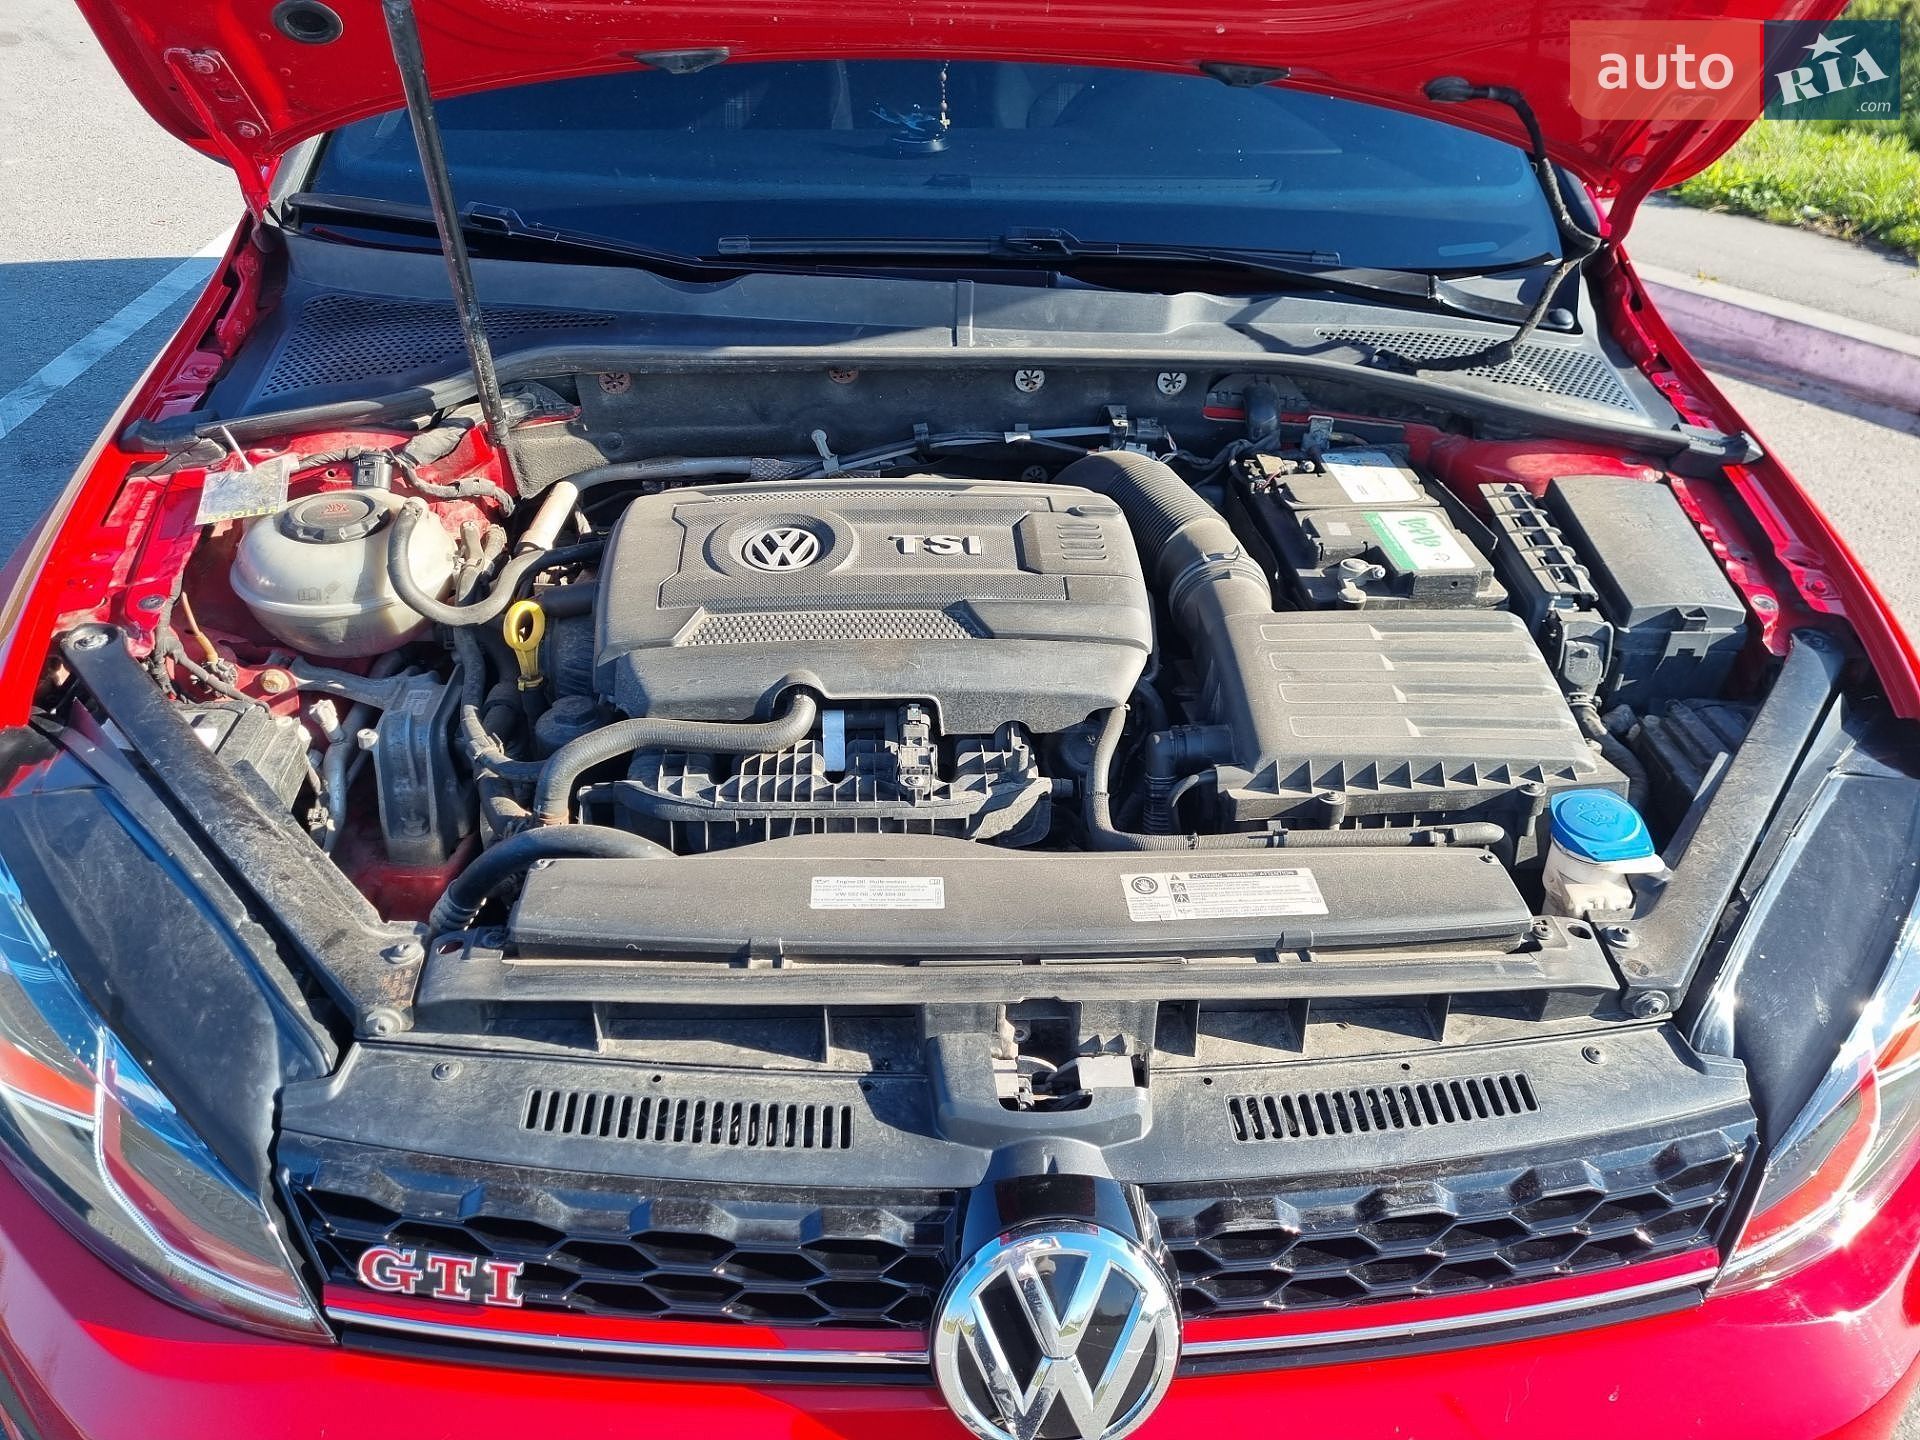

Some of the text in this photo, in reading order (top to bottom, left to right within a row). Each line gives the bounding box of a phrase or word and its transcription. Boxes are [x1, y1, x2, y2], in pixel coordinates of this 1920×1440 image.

[745, 527, 820, 572] VW
[888, 534, 983, 556] TSI
[358, 1245, 525, 1308] GTI
[933, 1226, 1180, 1440] VW
